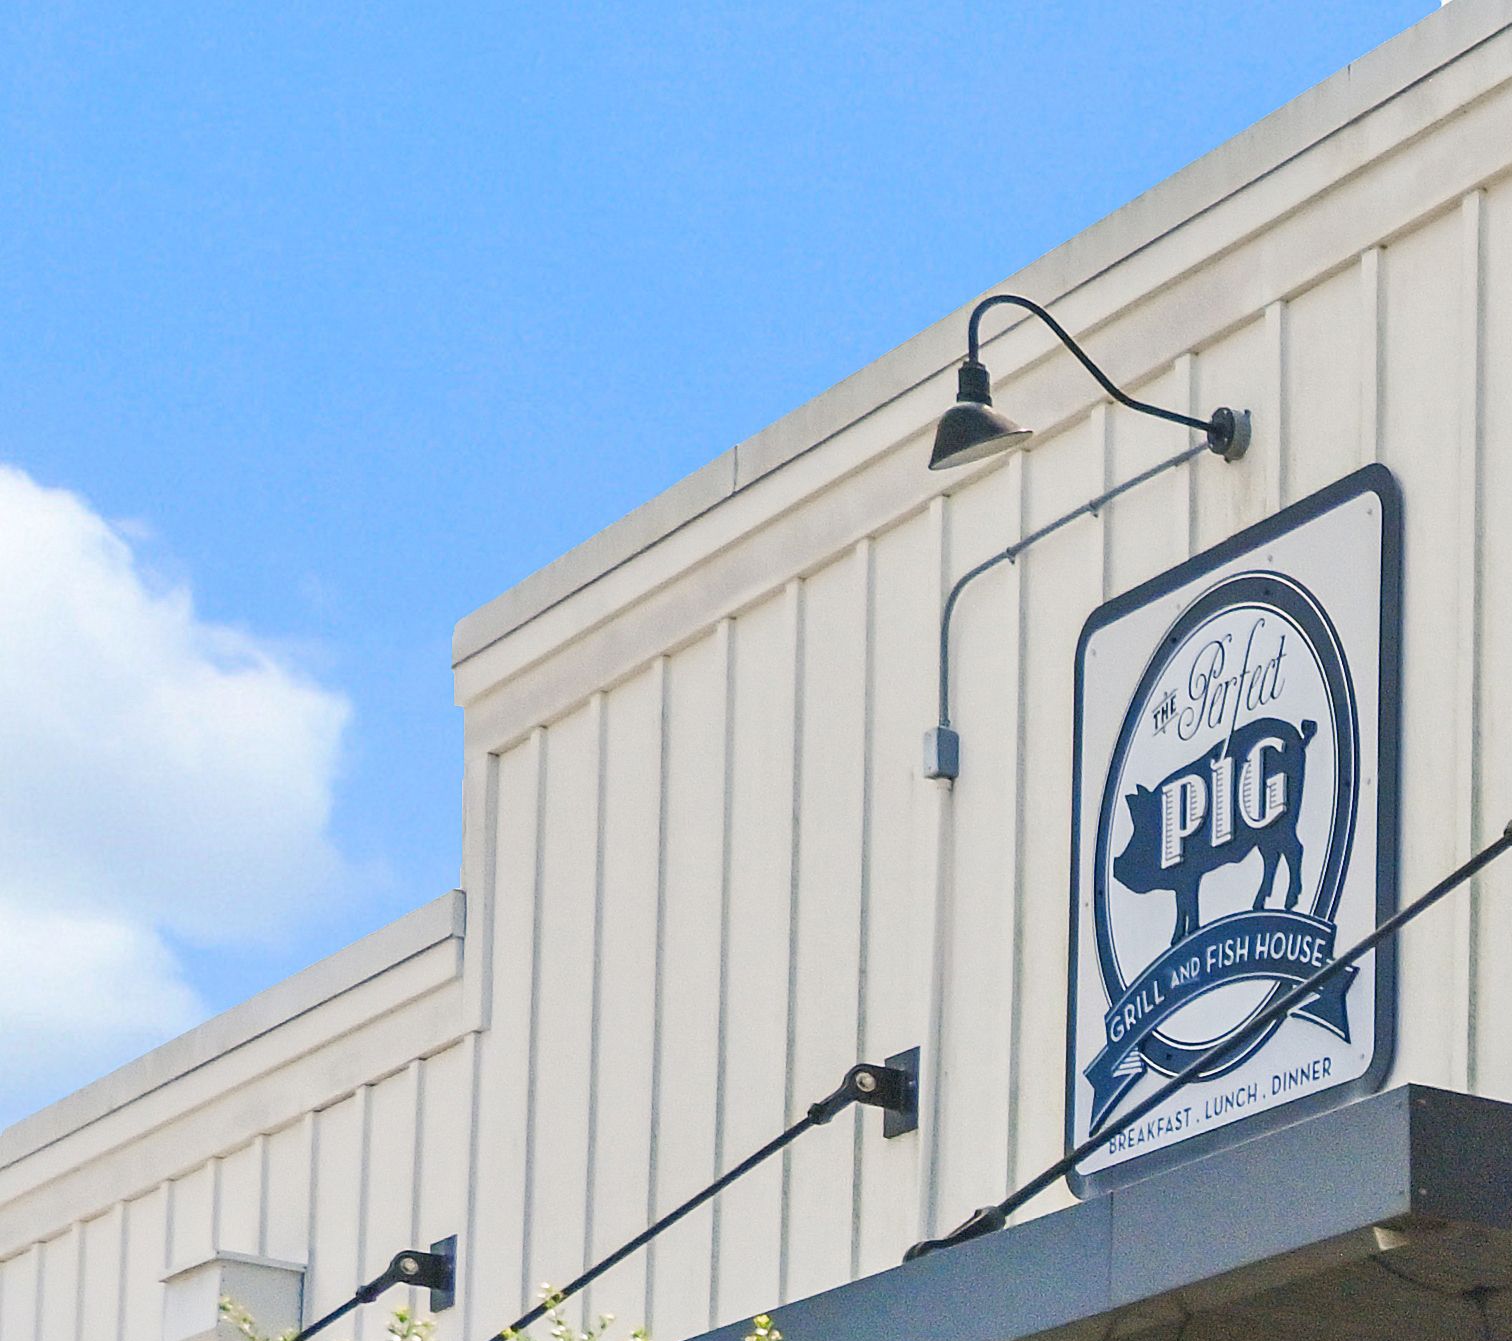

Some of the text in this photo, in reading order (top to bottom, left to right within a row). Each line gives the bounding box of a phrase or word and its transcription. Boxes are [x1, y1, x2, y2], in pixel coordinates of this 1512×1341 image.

[1153, 618, 1287, 758] THE Perfect
[1160, 738, 1287, 868] PIG
[1110, 931, 1327, 1043] GRILL AND FISH HOUSE
[1108, 1056, 1333, 1155] BREAKFAST LUNCH DINNER
